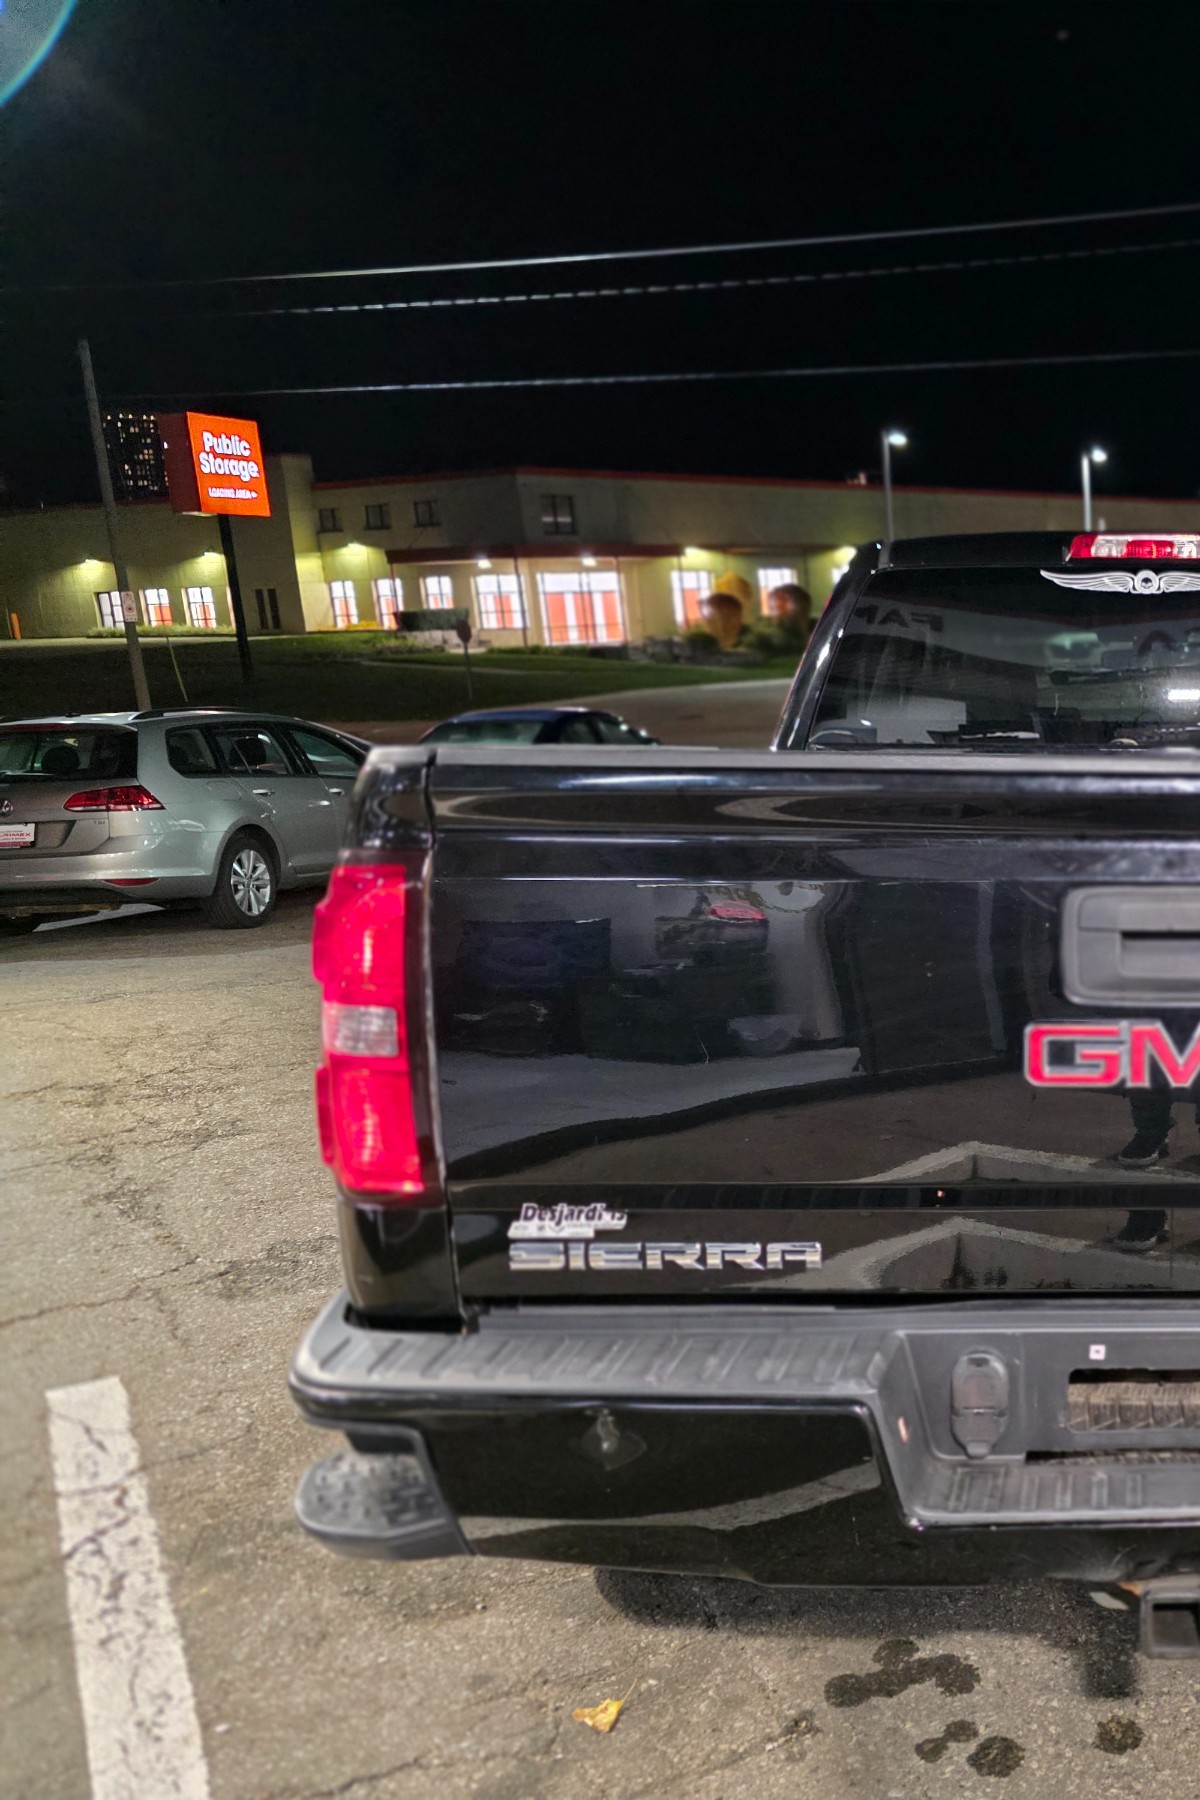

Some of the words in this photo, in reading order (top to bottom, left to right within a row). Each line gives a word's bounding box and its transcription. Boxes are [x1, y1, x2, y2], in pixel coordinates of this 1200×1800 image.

[203, 431, 250, 456] Public
[199, 453, 259, 481] Storage
[508, 1242, 823, 1270] SIERRA
